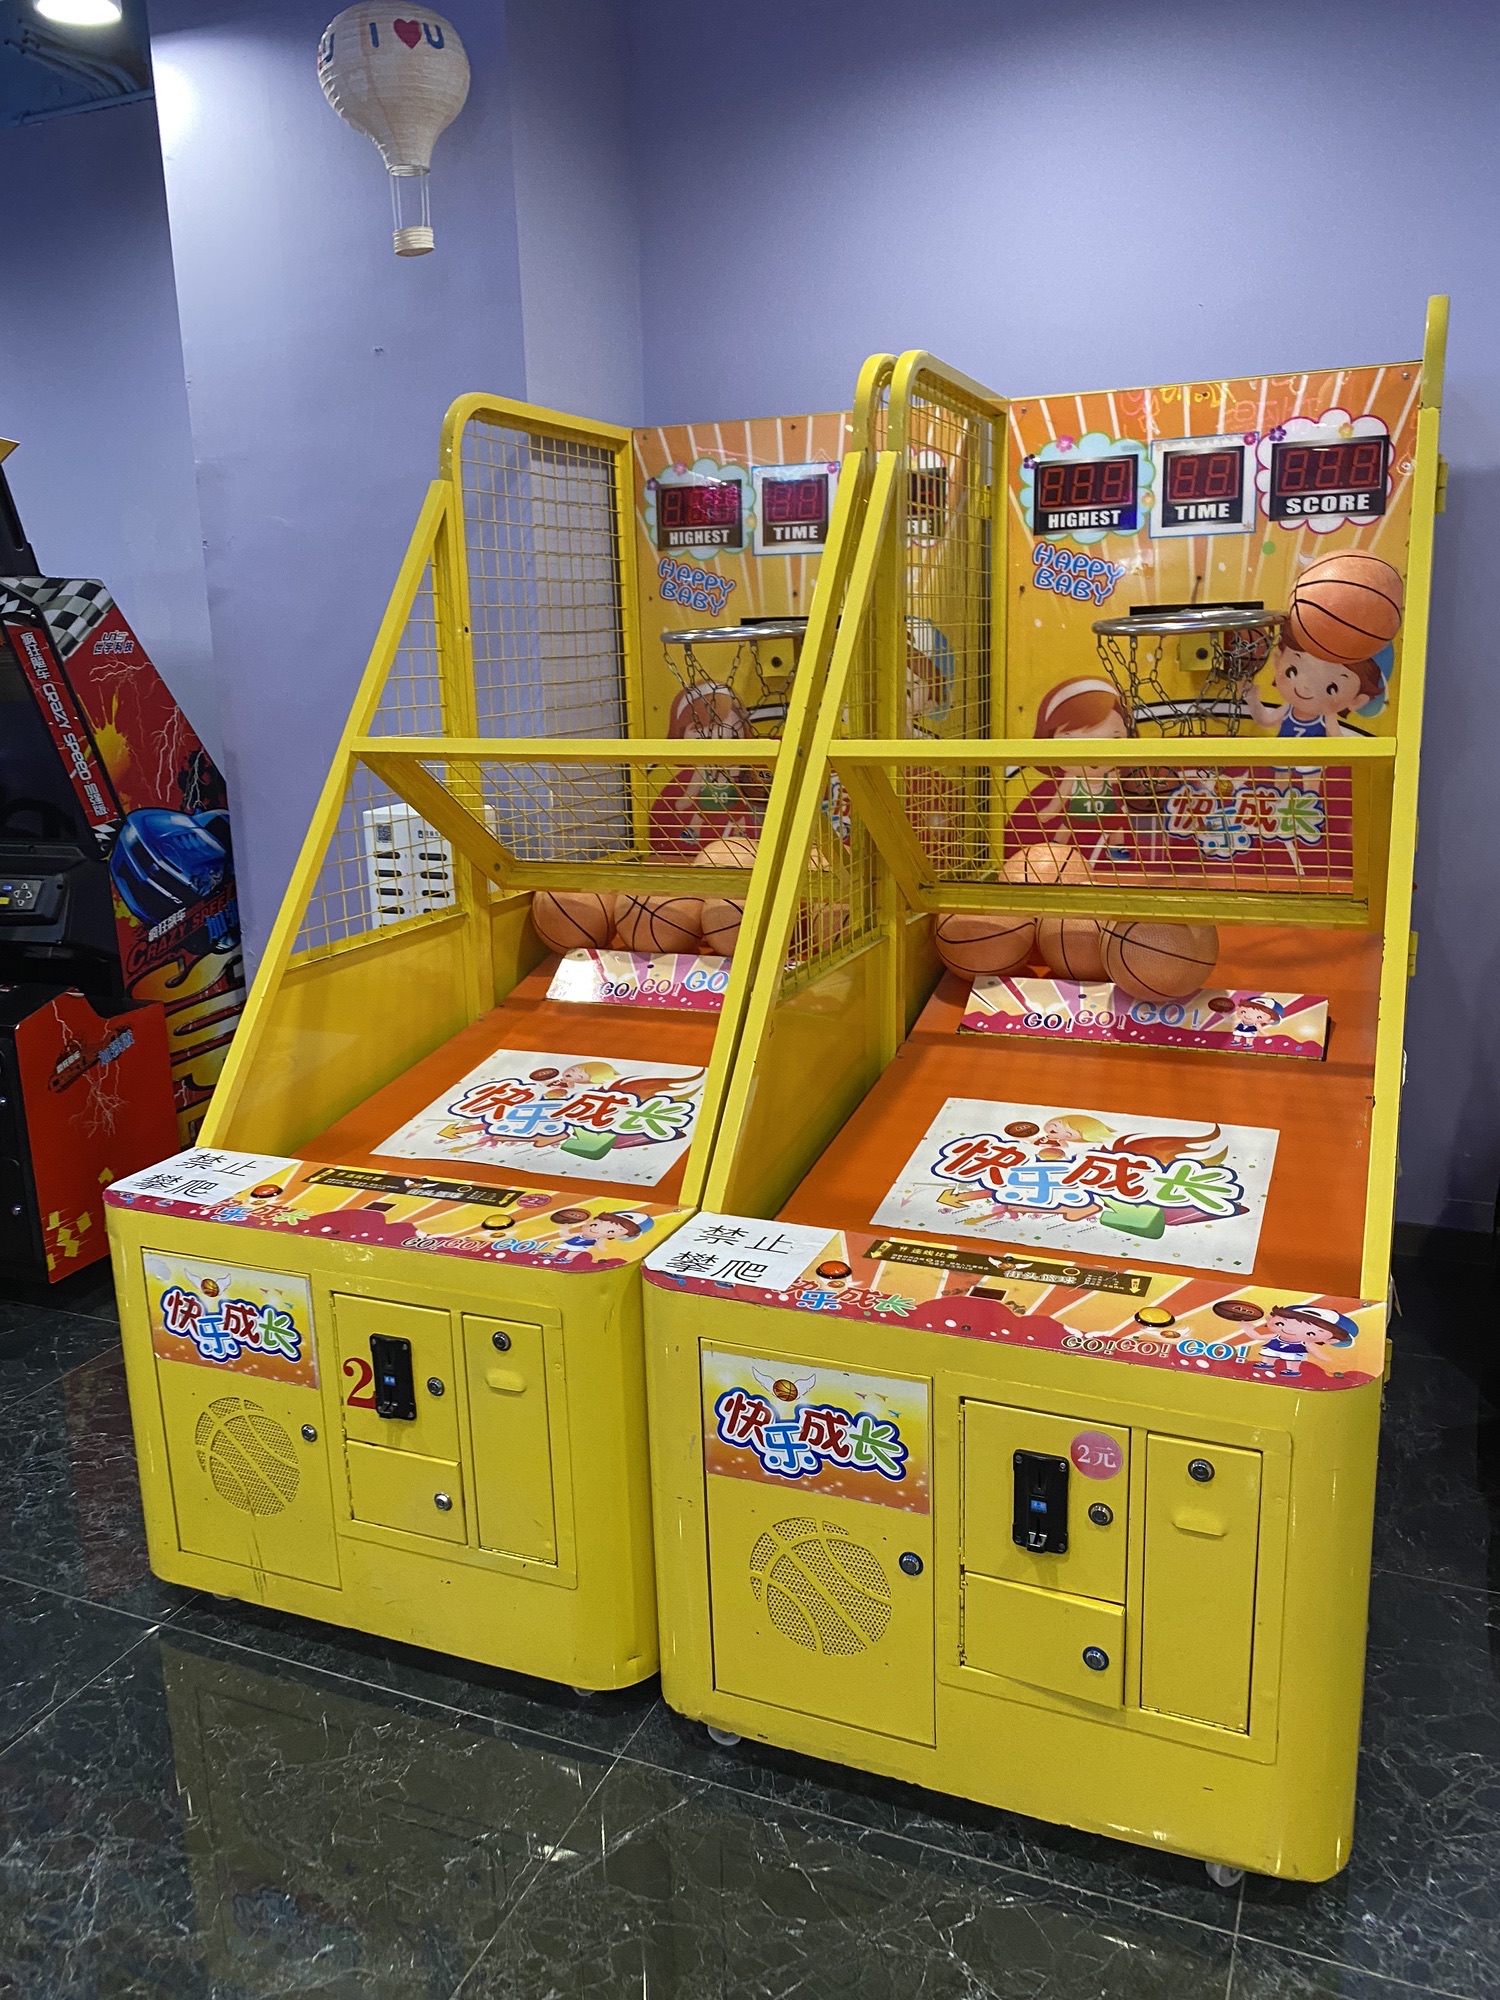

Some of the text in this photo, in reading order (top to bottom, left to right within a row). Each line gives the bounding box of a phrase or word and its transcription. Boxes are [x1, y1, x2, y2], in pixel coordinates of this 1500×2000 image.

[369, 22, 445, 49] I U
[1174, 503, 1230, 520] TIME
[1286, 493, 1370, 514] SCORE
[773, 525, 818, 540] TIME
[1048, 510, 1121, 528] HIGHEST
[669, 529, 730, 545] HIGHEST
[658, 558, 735, 597] HAPPY
[1033, 542, 1125, 588] HAPPY
[661, 581, 726, 617] BABY
[1034, 566, 1115, 606] BABY
[1084, 800, 1104, 812] 10
[1171, 790, 1321, 848] 快乐成长
[600, 970, 730, 1001] GO! GO! GO
[1024, 1001, 1199, 1033] GO! GO! GO!
[460, 1082, 682, 1136] 快乐成长
[175, 1153, 257, 1177] 禁止
[942, 1139, 1233, 1210] 快乐成长
[131, 1173, 219, 1198] 攀爬
[401, 1237, 549, 1255] GO! GO! GO!
[693, 1225, 794, 1255] 禁止
[665, 1251, 769, 1283] 攀爬
[167, 1290, 297, 1355] 快乐成长
[1061, 1336, 1250, 1364] GO! GO! GO!
[343, 1357, 377, 1410] 2
[723, 1393, 903, 1471] 快乐成长
[1077, 1443, 1119, 1469] 2元
